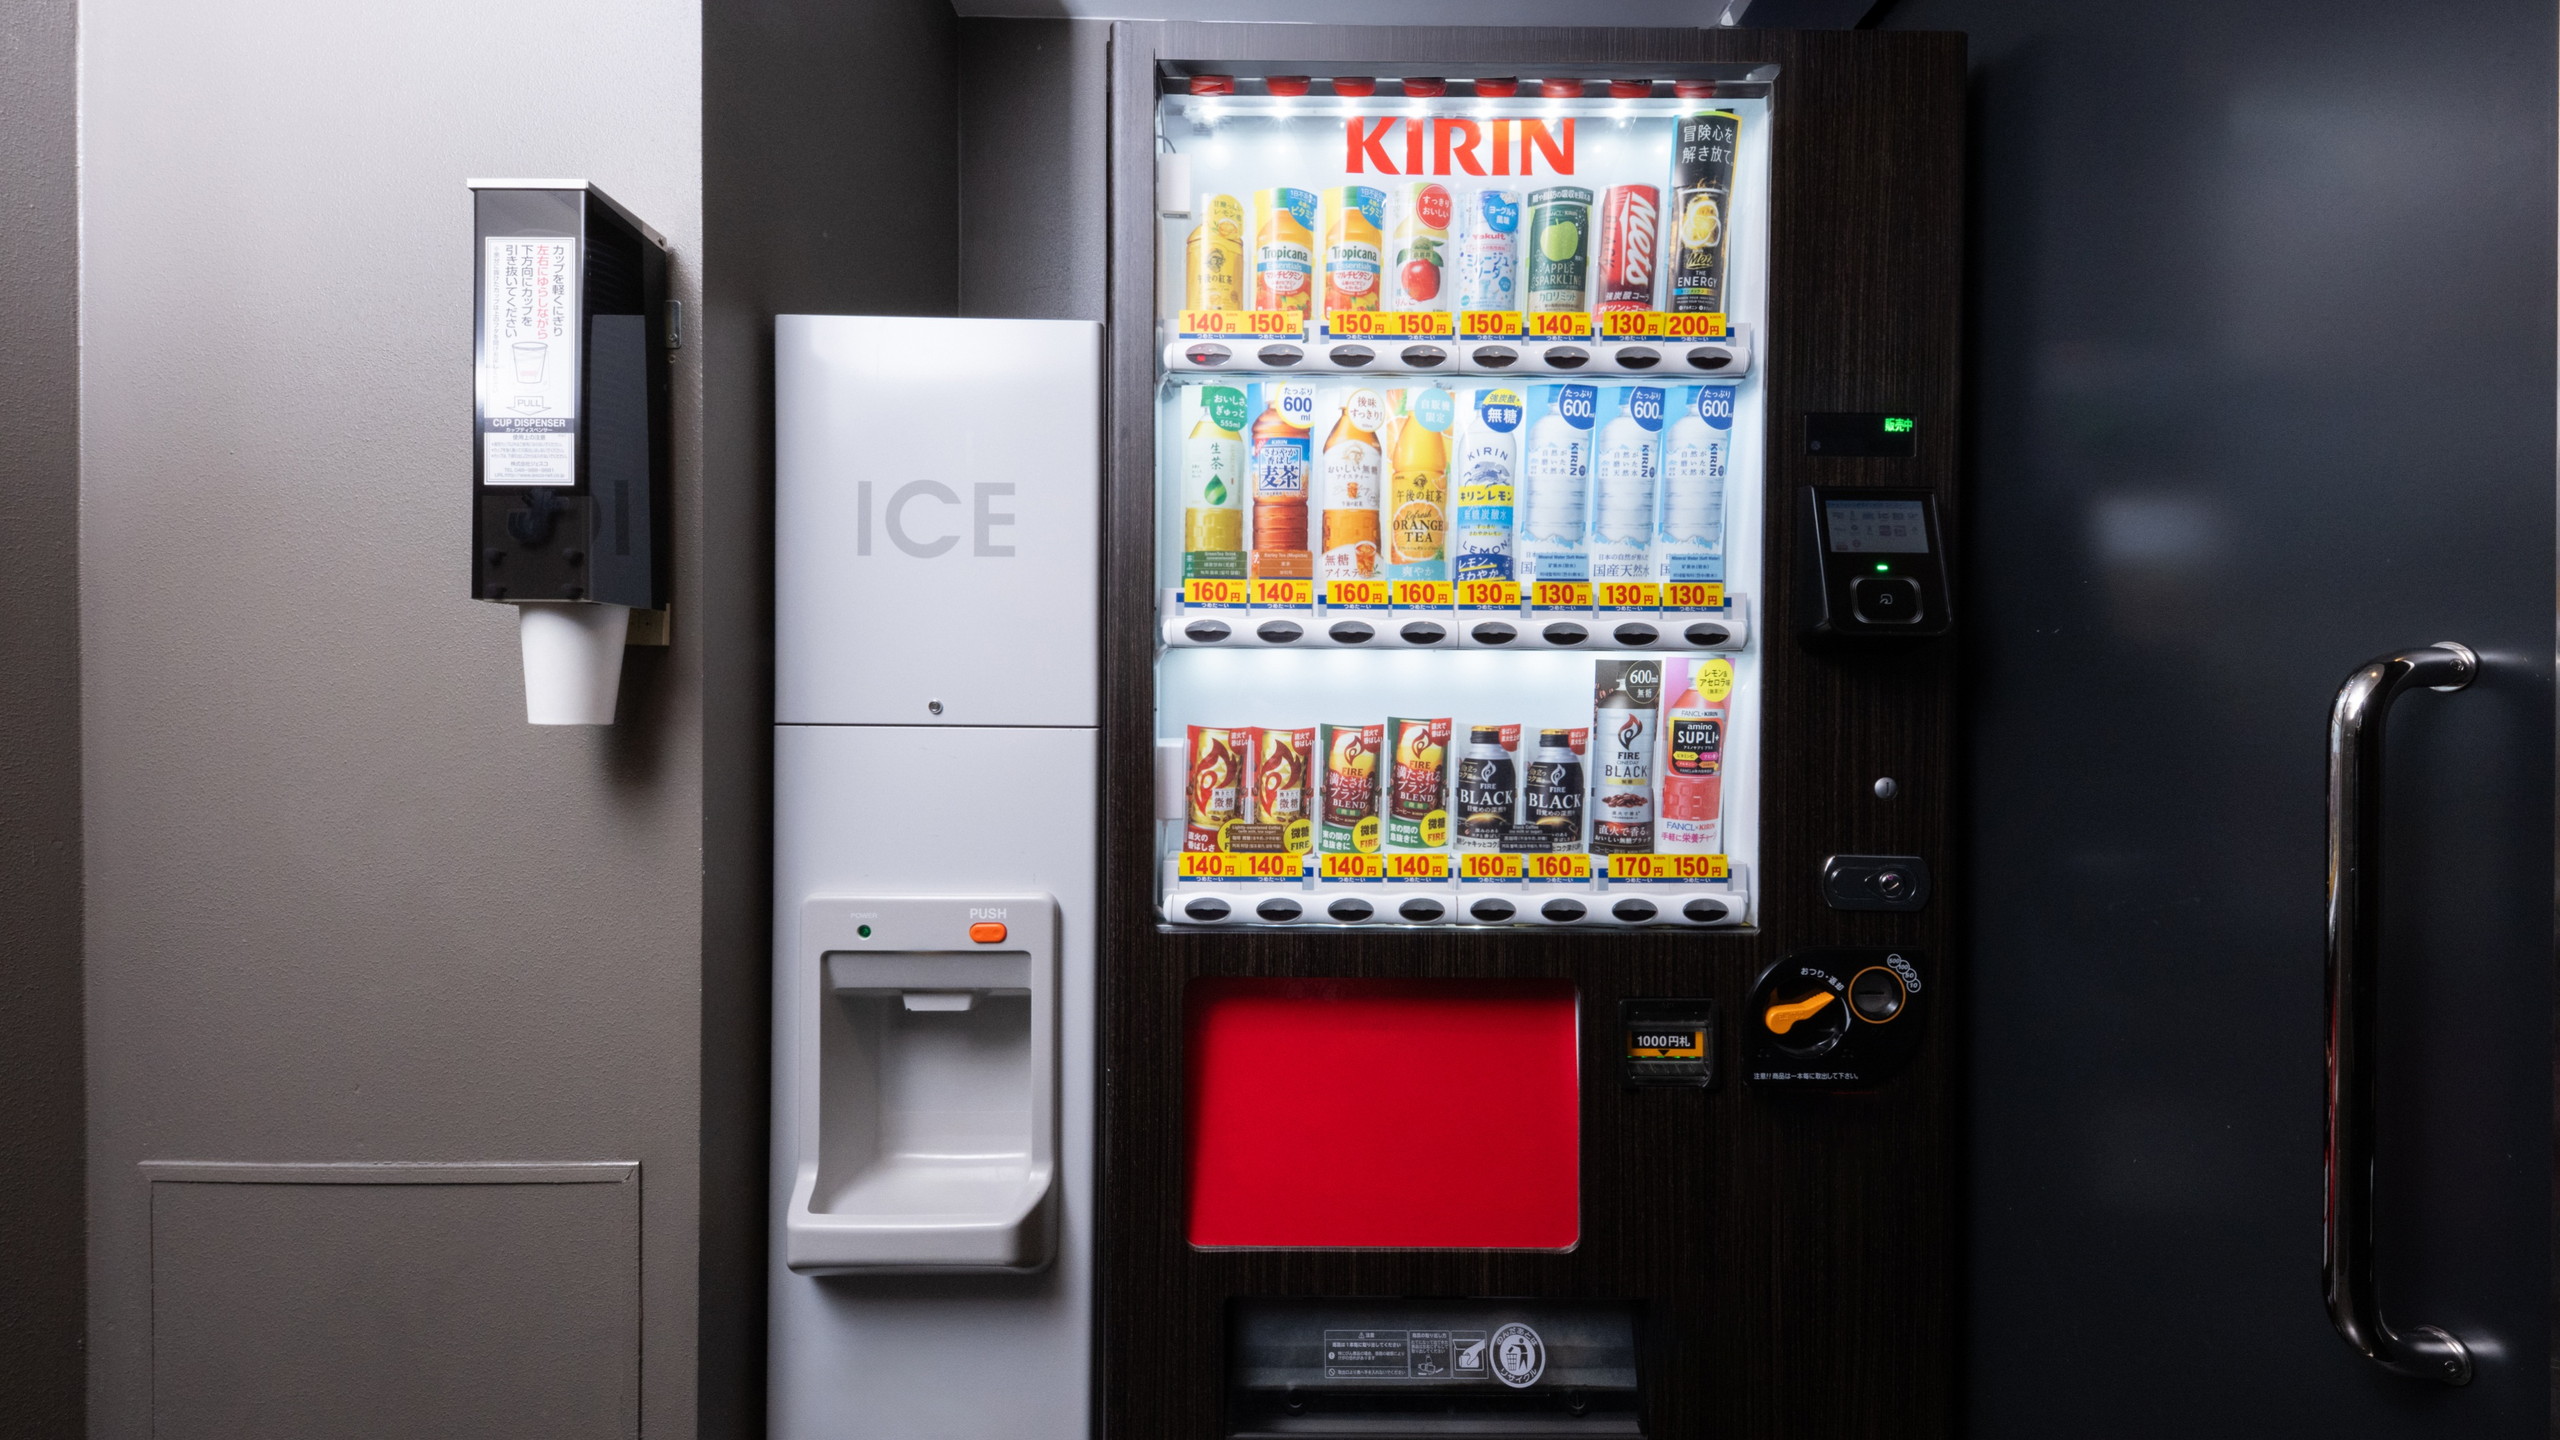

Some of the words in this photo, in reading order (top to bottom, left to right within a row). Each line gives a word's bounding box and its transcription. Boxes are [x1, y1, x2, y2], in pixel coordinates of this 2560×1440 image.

[1683, 124, 1733, 145] 冒険心を
[1346, 117, 1576, 176] KIRIN
[1682, 146, 1734, 167] 解き放て。
[1423, 196, 1449, 208] すっきり
[1489, 205, 1516, 216] ヨーグルト
[1422, 207, 1449, 218] おいしい
[1626, 191, 1657, 287] Mets
[1262, 246, 1308, 262] Tropicana
[1332, 246, 1377, 262] Tropicana
[1546, 262, 1575, 274] APPLE
[521, 244, 534, 327] 下方向にカップを
[1677, 276, 1718, 288] ENERGY
[505, 244, 518, 338] 引き抜いてください
[536, 244, 549, 340] 左右にゆらしながら
[552, 244, 565, 338] カップを軽くにぎり
[1188, 313, 1236, 332] 140円
[1248, 313, 1297, 333] 150円
[1337, 314, 1385, 333] 150円
[1398, 314, 1447, 333] 150円
[1468, 314, 1516, 334] 150円
[1537, 315, 1585, 334] 140円
[1611, 314, 1658, 334] 130円
[1669, 315, 1720, 335] 200円
[1284, 386, 1313, 395] たっぷり
[1565, 389, 1592, 398] たっぷり
[1636, 391, 1661, 400] たっぷり
[1704, 389, 1731, 399] たっぷり
[517, 399, 541, 407] PULL
[1283, 396, 1312, 412] 600
[1357, 396, 1377, 407] 後味
[1215, 405, 1245, 418] ぎゅっと
[1487, 407, 1517, 424] 無糖
[492, 418, 512, 427] CUP
[514, 418, 566, 428] DISPENSER
[1884, 417, 1913, 432] 販売中
[1210, 442, 1224, 470] 生茶
[1467, 446, 1509, 461] KIRIN
[1569, 442, 1579, 477] KIRIN
[1641, 444, 1649, 478] KIRIN
[1709, 443, 1718, 477] KIRIN
[1261, 465, 1299, 488] 麦茶
[1396, 490, 1444, 502] 午後の紅茶
[857, 479, 1016, 559] ICE
[1393, 515, 1444, 531] ORANGE
[1404, 532, 1433, 542] TEA
[1462, 540, 1507, 554] LEMON
[1325, 554, 1349, 566] 無糖
[1593, 564, 1650, 578] 国産天然水
[1192, 581, 1240, 602] 160円
[1258, 582, 1306, 603] 140円
[1334, 583, 1383, 603] 160円
[1400, 583, 1448, 603] 160円
[1467, 583, 1515, 604] 130円
[1539, 584, 1587, 604] 130円
[1606, 584, 1654, 605] 130円
[1670, 585, 1718, 605] 130円
[1687, 722, 1713, 731] amino
[1617, 752, 1640, 760] FIRE
[1341, 767, 1364, 776] FIRE
[1396, 765, 1440, 782] 満たされる
[1409, 760, 1432, 770] FIRE
[1605, 764, 1648, 777] BLACK
[1329, 772, 1373, 789] 満たされる
[1397, 780, 1438, 794] ブラジル
[1330, 787, 1370, 801] ブラジル
[1400, 791, 1434, 802] BLEND
[1460, 789, 1513, 805] BLACK
[1528, 792, 1581, 809] BLACK
[1332, 798, 1366, 809] BLEND
[1360, 823, 1378, 836] 微糖
[1427, 817, 1446, 830] 微糖
[1666, 821, 1695, 831] FANCL
[1698, 823, 1716, 831] KIRIN
[1290, 826, 1310, 839] 微糖
[1427, 831, 1446, 842] FIRE
[1290, 840, 1310, 850] FIRE
[1360, 838, 1378, 848] FIRE
[1186, 855, 1235, 875] 140円
[1249, 855, 1296, 875] 140円
[1329, 856, 1376, 876] 140円
[1395, 856, 1442, 876] 140円
[1469, 856, 1516, 876] 160円
[1536, 856, 1584, 876] 160円
[1615, 857, 1663, 876] 170円
[1673, 857, 1721, 876] 150円
[969, 907, 1007, 919] PUSH
[1800, 967, 1845, 991] おつり・返却
[1637, 1034, 1690, 1047] 1000円札
[1496, 1326, 1539, 1347] のんだあとは
[1500, 1367, 1538, 1384] リサイクル
